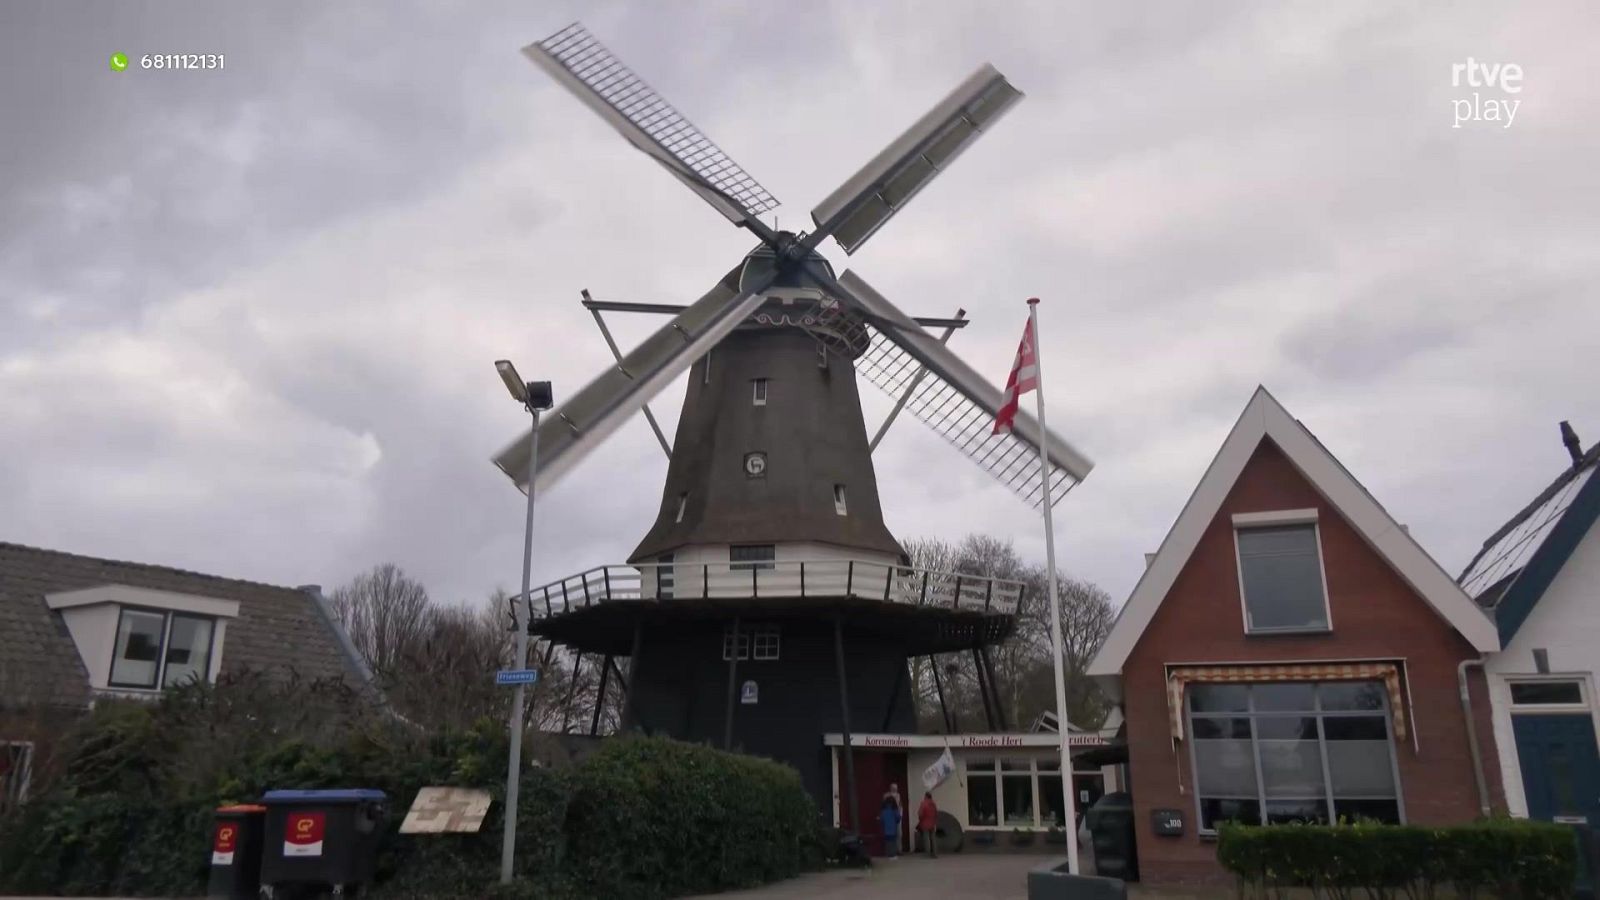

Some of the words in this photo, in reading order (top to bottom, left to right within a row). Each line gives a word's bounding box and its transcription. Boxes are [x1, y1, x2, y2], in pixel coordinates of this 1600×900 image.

[865, 735, 909, 746] Korenmolen
[969, 735, 1000, 746] Roode
[1001, 735, 1023, 746] Hert
